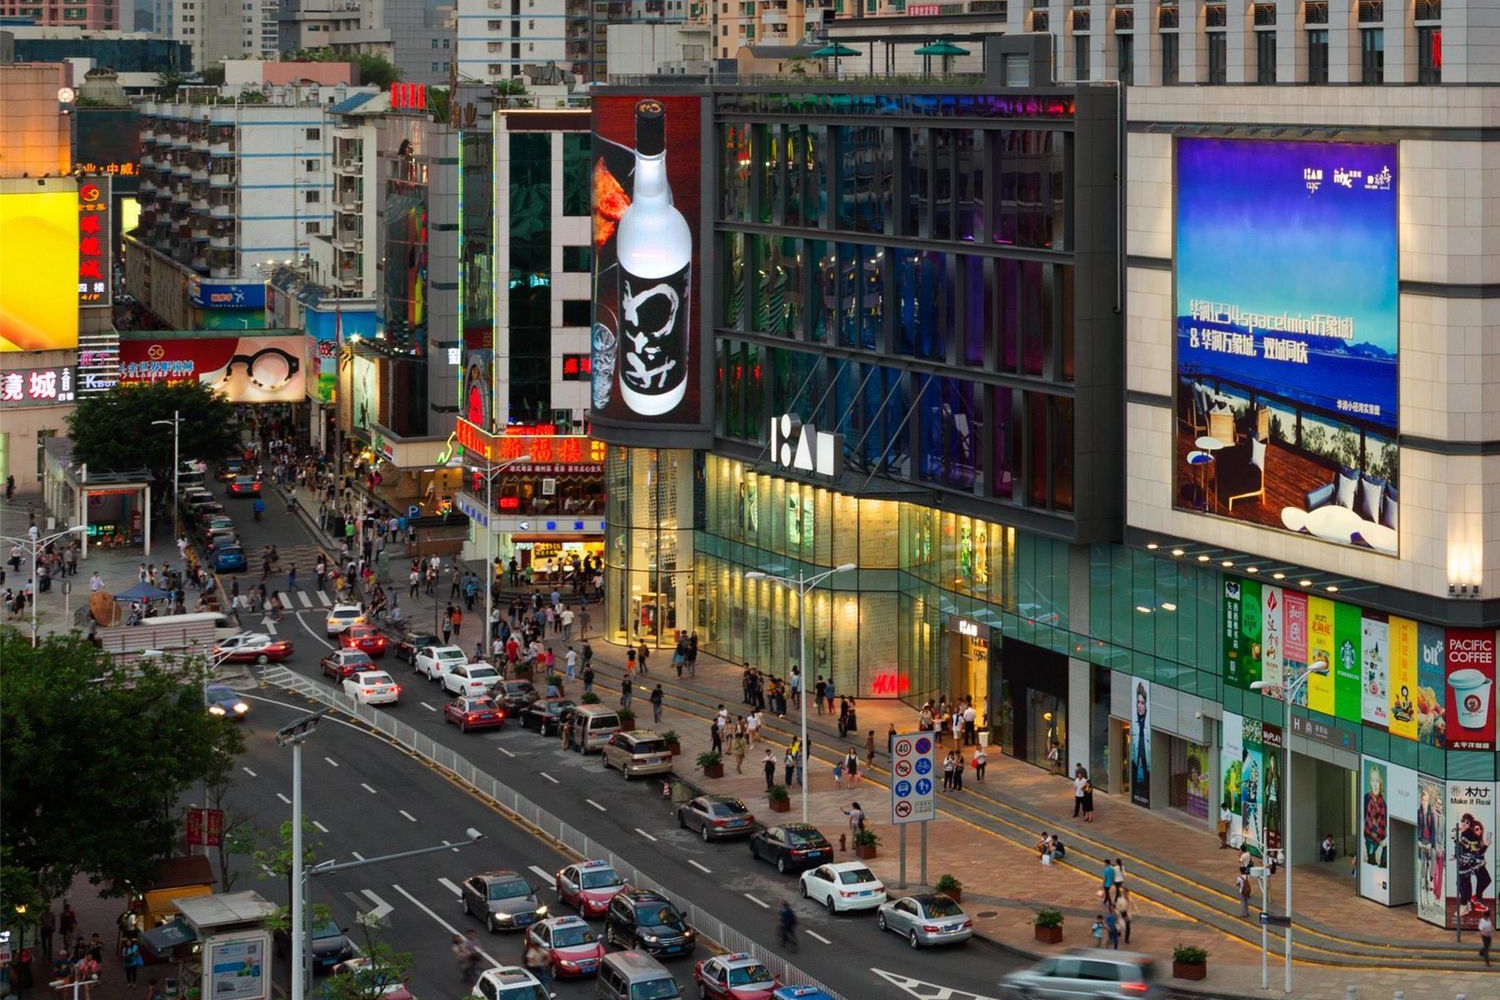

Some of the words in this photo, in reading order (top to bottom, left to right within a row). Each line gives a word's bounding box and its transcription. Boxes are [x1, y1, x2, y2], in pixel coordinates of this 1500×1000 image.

[1190, 328, 1200, 348] &
[1263, 336, 1309, 364] 双城同庆
[408, 505, 419, 518] P
[1449, 639, 1492, 651] PACIFIC
[1449, 651, 1492, 664] COFFEE
[1293, 718, 1301, 730] H
[898, 743, 908, 753] 40
[1476, 798, 1491, 806] Real
